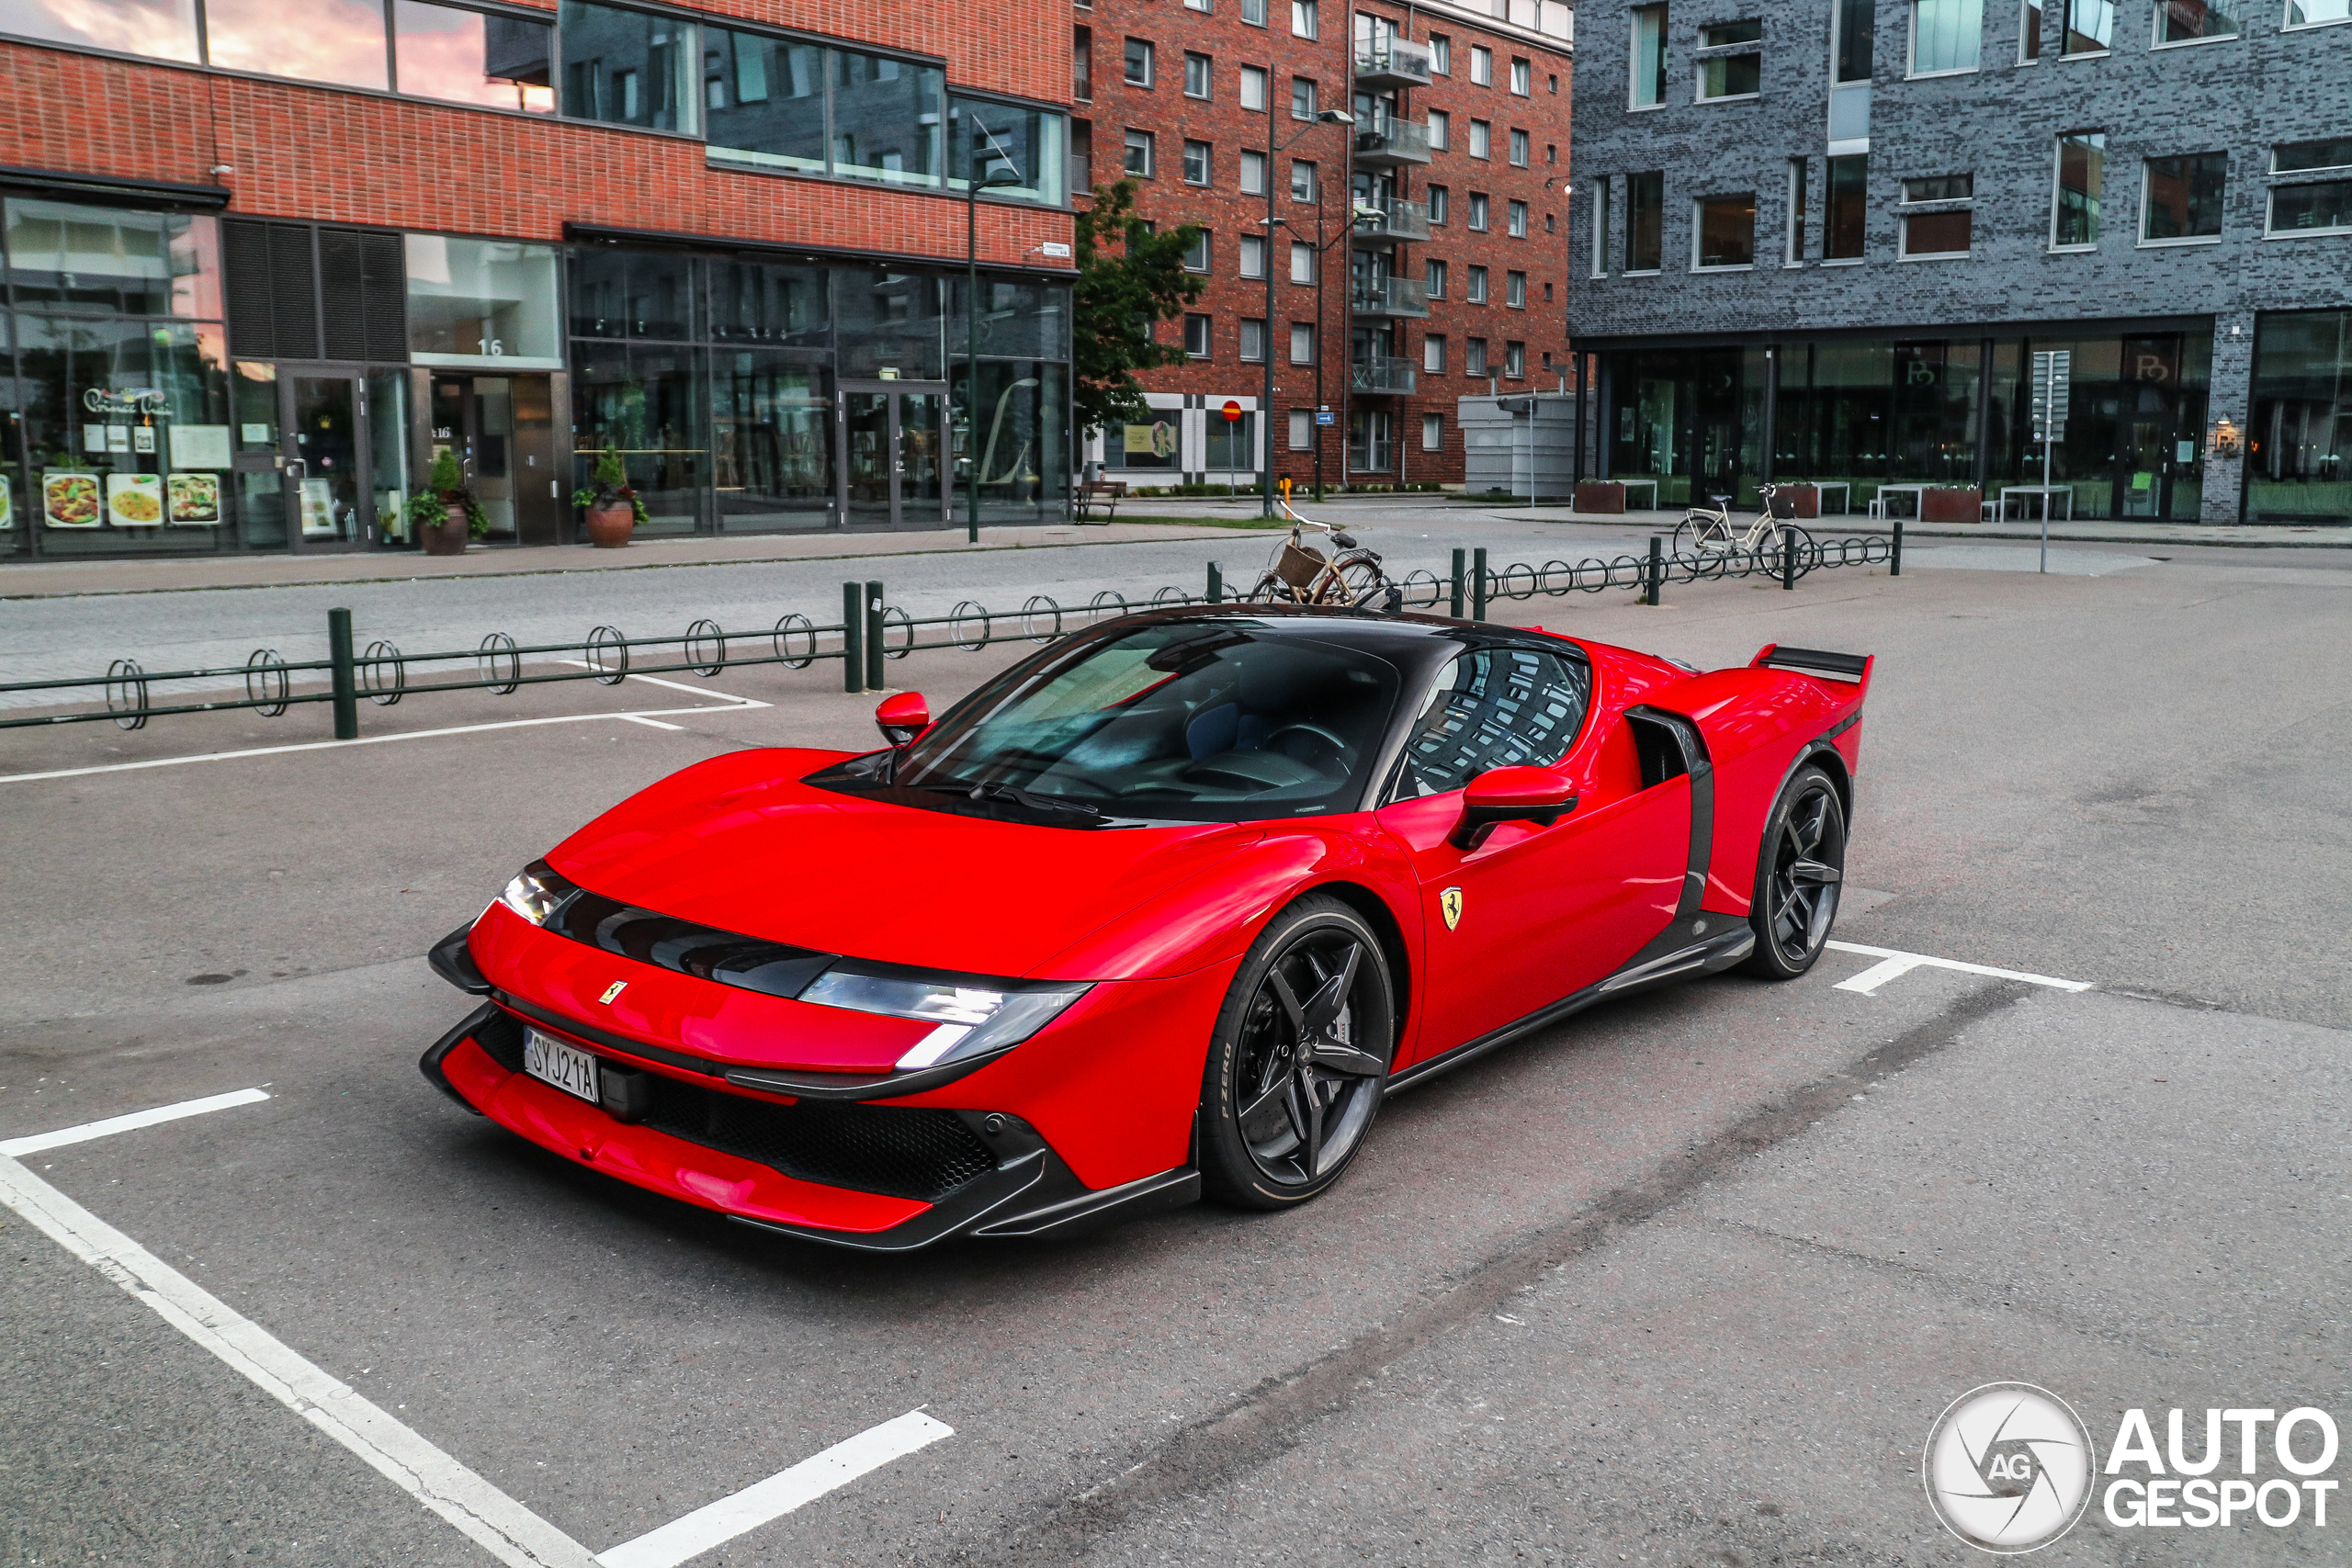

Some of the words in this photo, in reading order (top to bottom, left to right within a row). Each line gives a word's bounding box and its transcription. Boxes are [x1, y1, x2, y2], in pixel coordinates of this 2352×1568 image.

[478, 339, 503, 355] 16
[437, 426, 451, 438] 16
[533, 1036, 594, 1096] SYJ21A
[1221, 1042, 1232, 1101] ZERO
[1222, 1105, 1229, 1119] P
